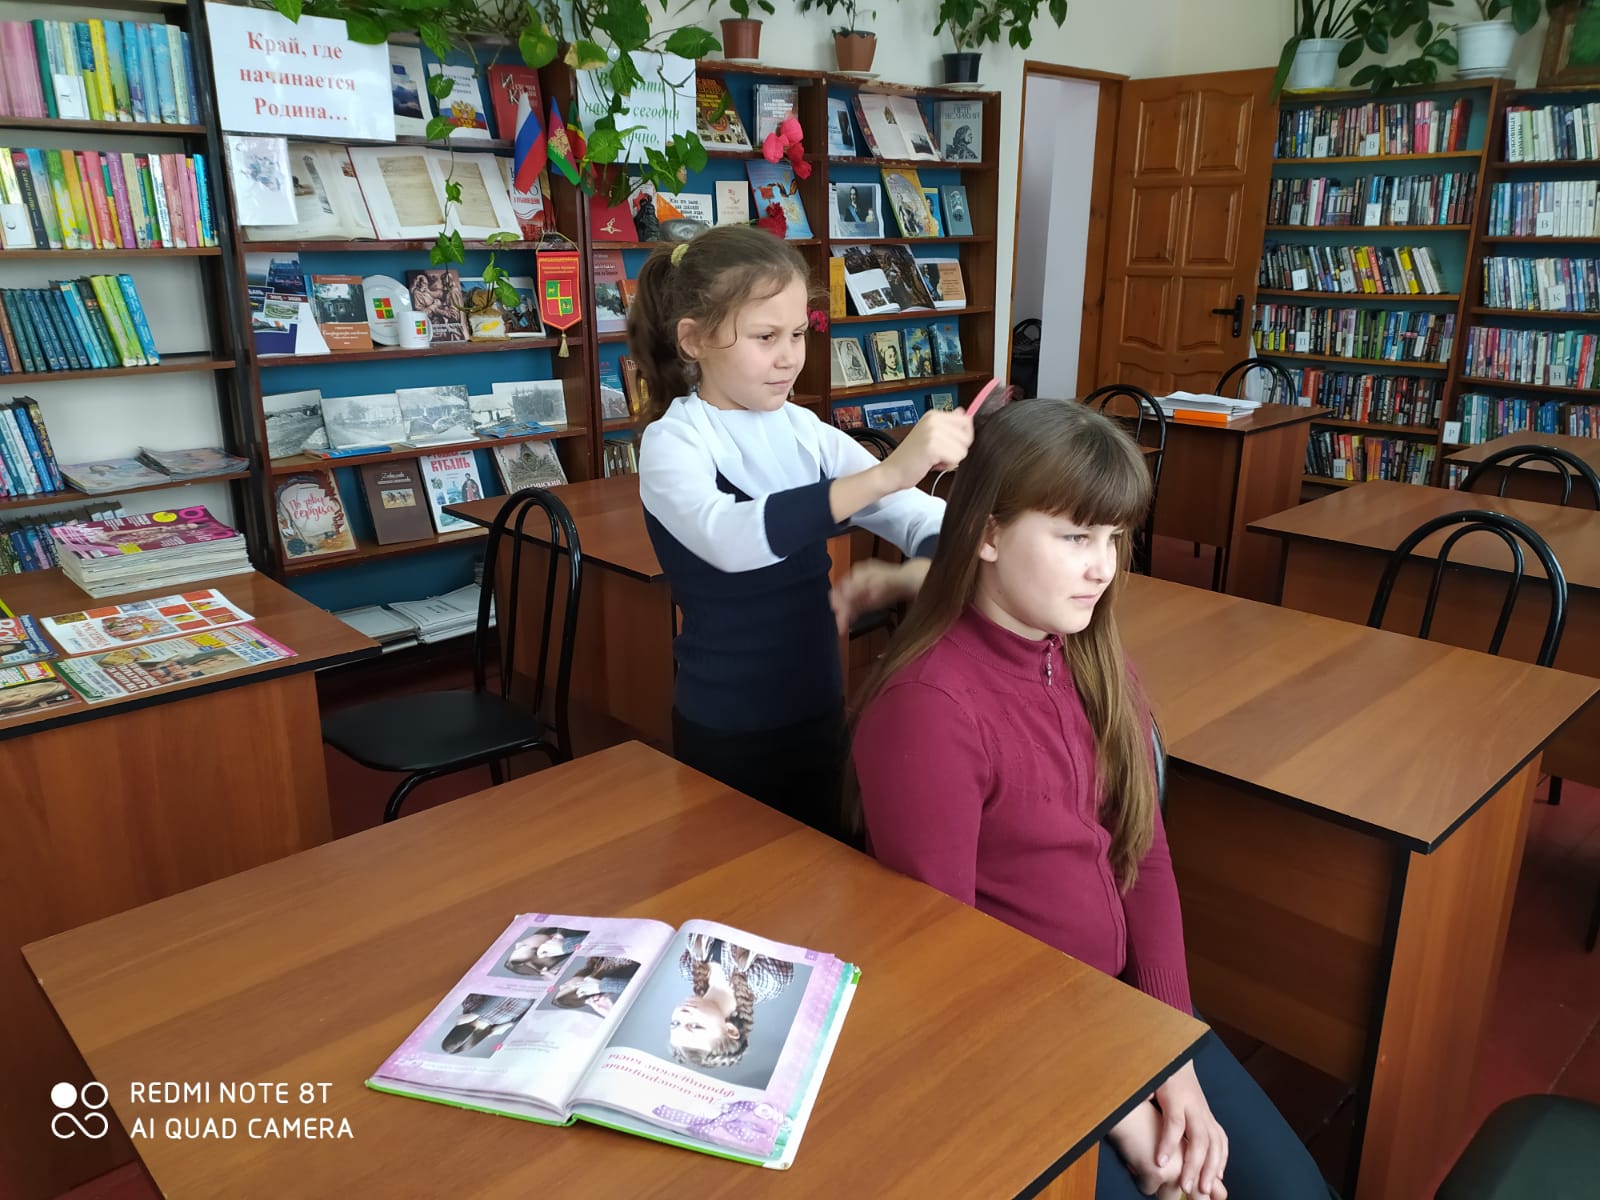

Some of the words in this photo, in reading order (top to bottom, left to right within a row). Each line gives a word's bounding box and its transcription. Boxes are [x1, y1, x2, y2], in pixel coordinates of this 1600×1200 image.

[247, 31, 307, 58] Край,
[312, 43, 343, 60] где
[240, 68, 356, 92] начинается
